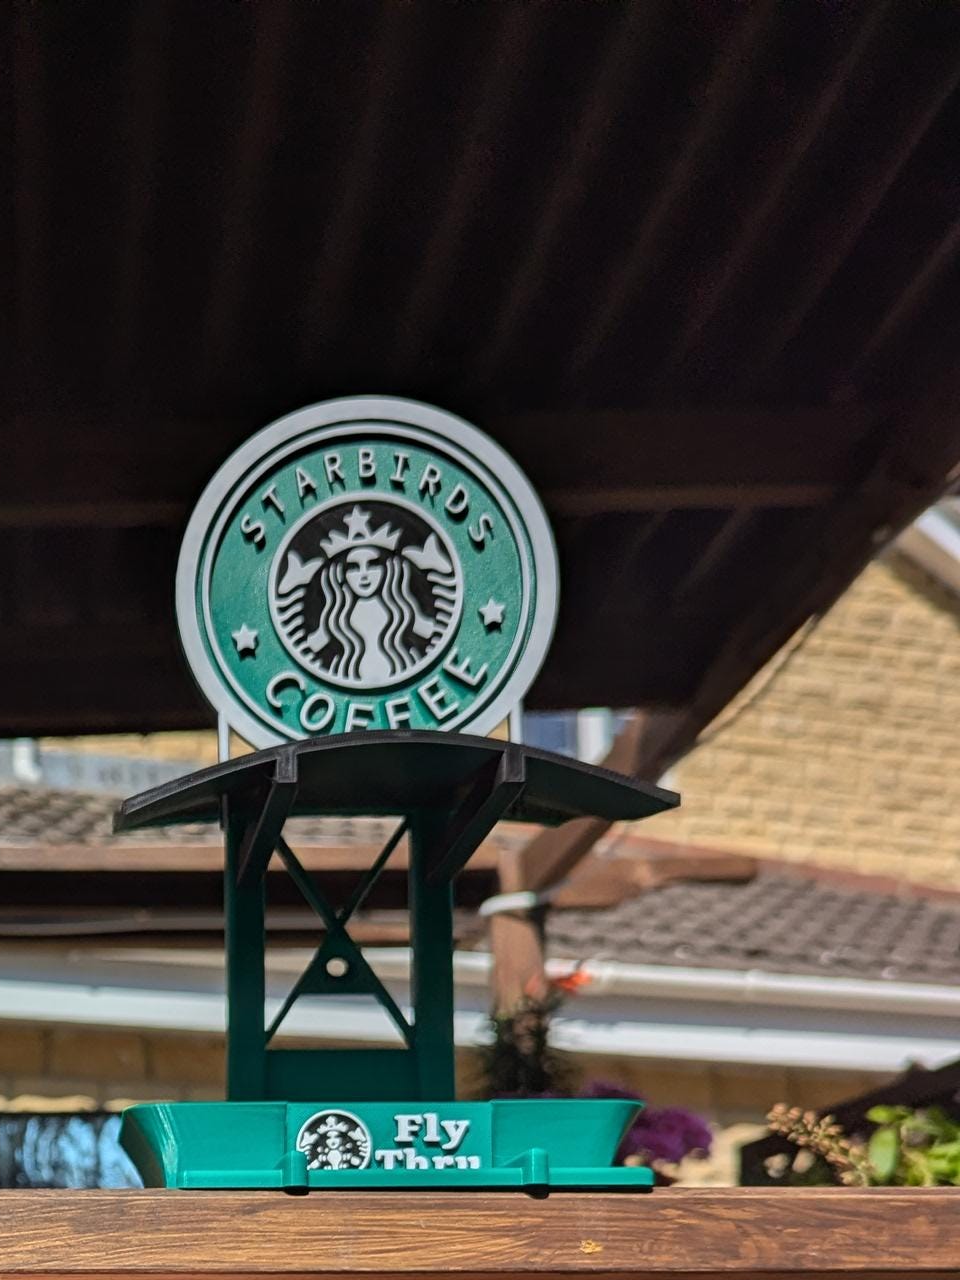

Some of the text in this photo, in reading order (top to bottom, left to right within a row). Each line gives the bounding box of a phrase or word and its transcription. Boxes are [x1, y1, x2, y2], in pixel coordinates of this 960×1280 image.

[241, 447, 495, 546] STARBIRDS
[266, 648, 490, 734] COFFEE
[375, 1148, 480, 1170] Thru
[394, 1112, 471, 1150] Fly
